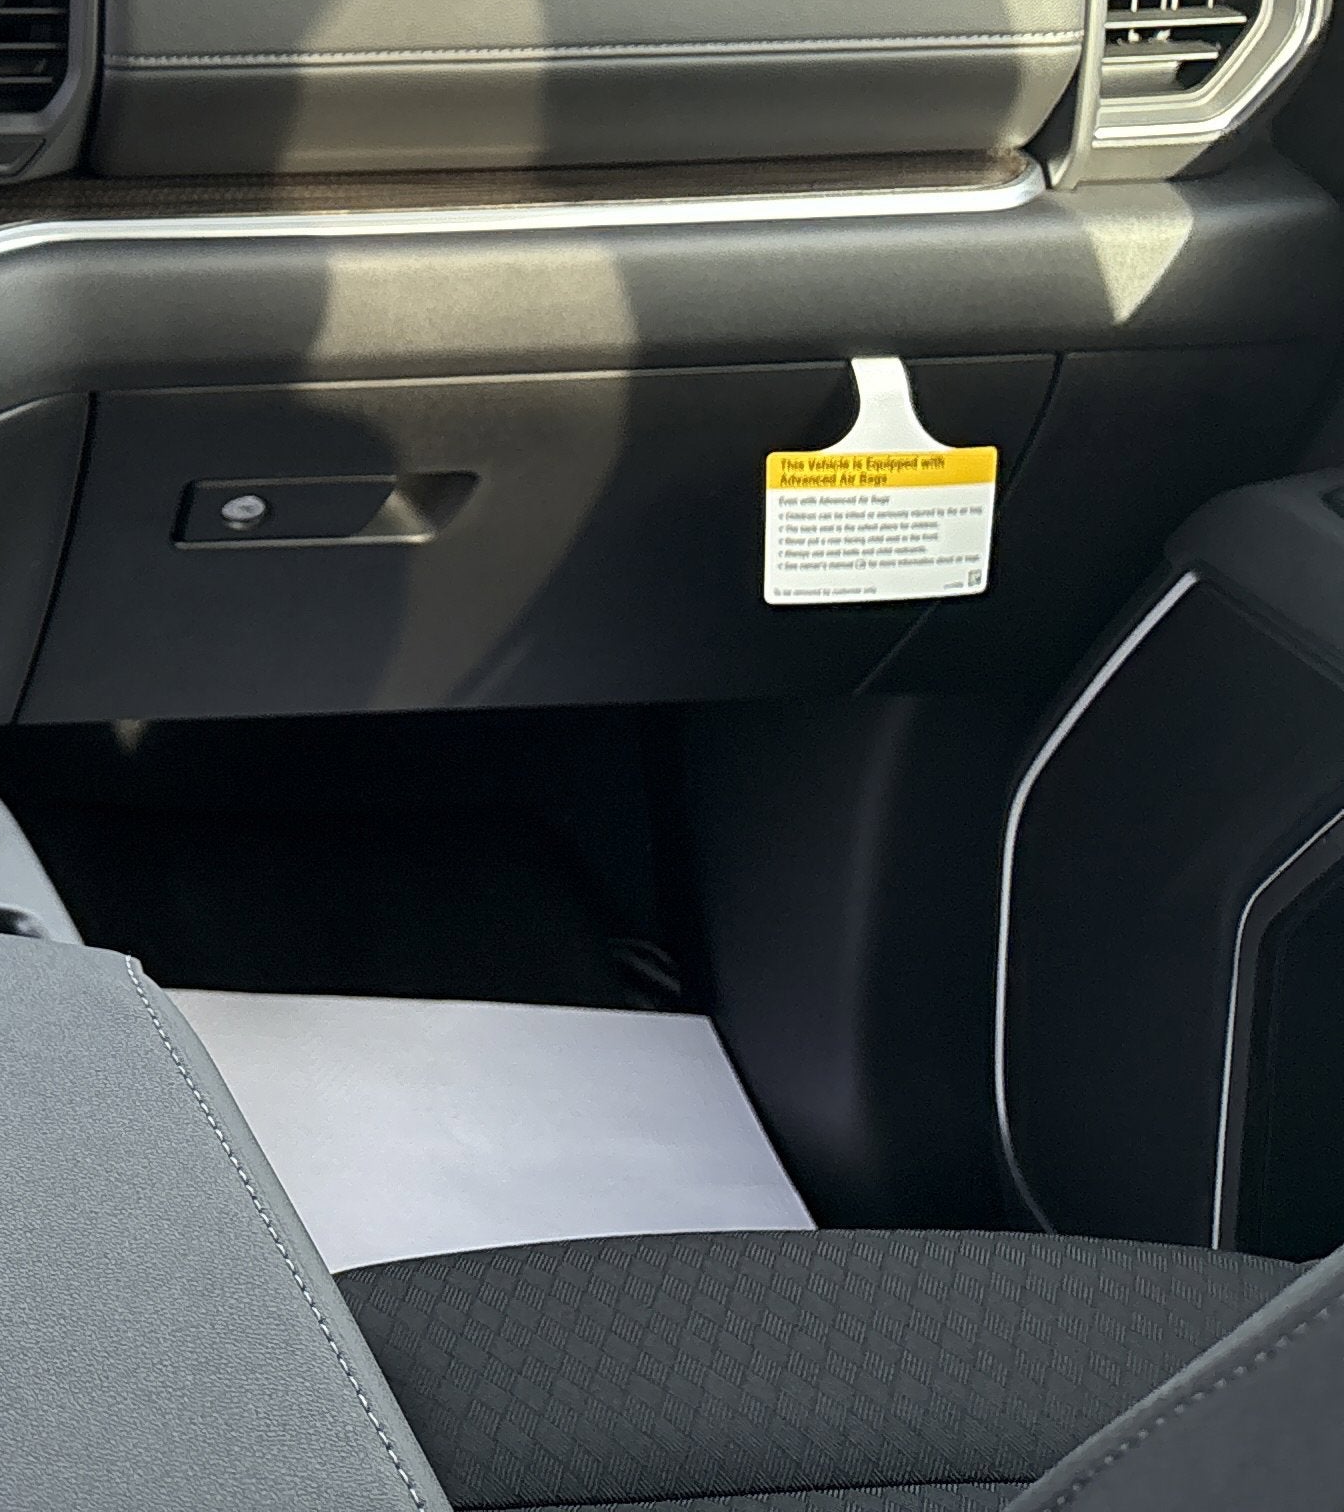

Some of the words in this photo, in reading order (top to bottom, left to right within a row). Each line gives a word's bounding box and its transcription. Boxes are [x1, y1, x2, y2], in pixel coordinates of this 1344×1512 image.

[780, 458, 805, 470] This
[808, 457, 850, 470] Vehicle
[852, 457, 863, 470] is
[866, 456, 918, 472] Equipped
[920, 455, 945, 468] with
[780, 473, 836, 486] Advanced
[839, 473, 856, 485] Air
[859, 473, 888, 485] Bags
